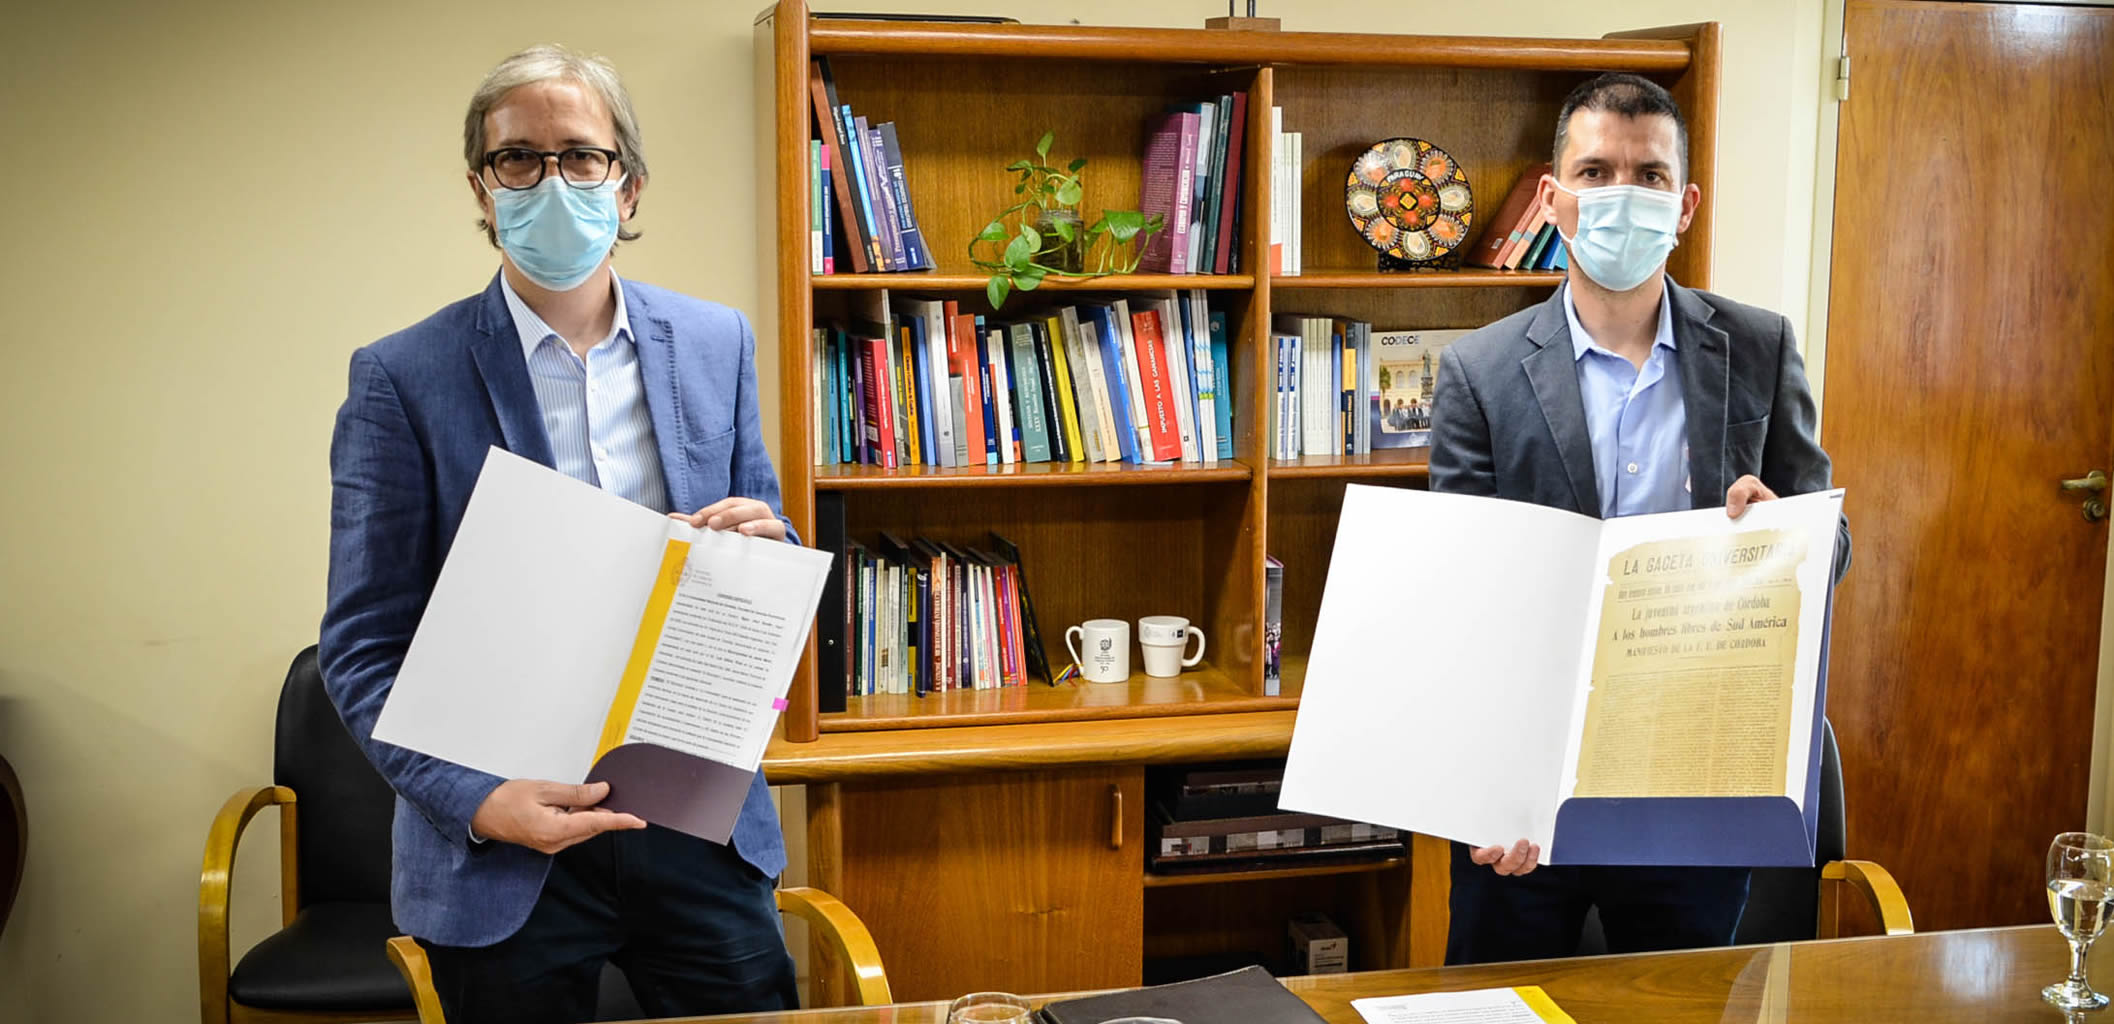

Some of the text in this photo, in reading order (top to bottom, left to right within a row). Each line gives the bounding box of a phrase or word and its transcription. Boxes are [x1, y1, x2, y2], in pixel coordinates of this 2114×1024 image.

[1387, 170, 1424, 182] PARAGUAY
[1147, 340, 1159, 377] GANANCIAS
[1157, 401, 1167, 433] IMPUESTO
[1624, 559, 1638, 575] LA
[1646, 553, 1693, 573] GACETA
